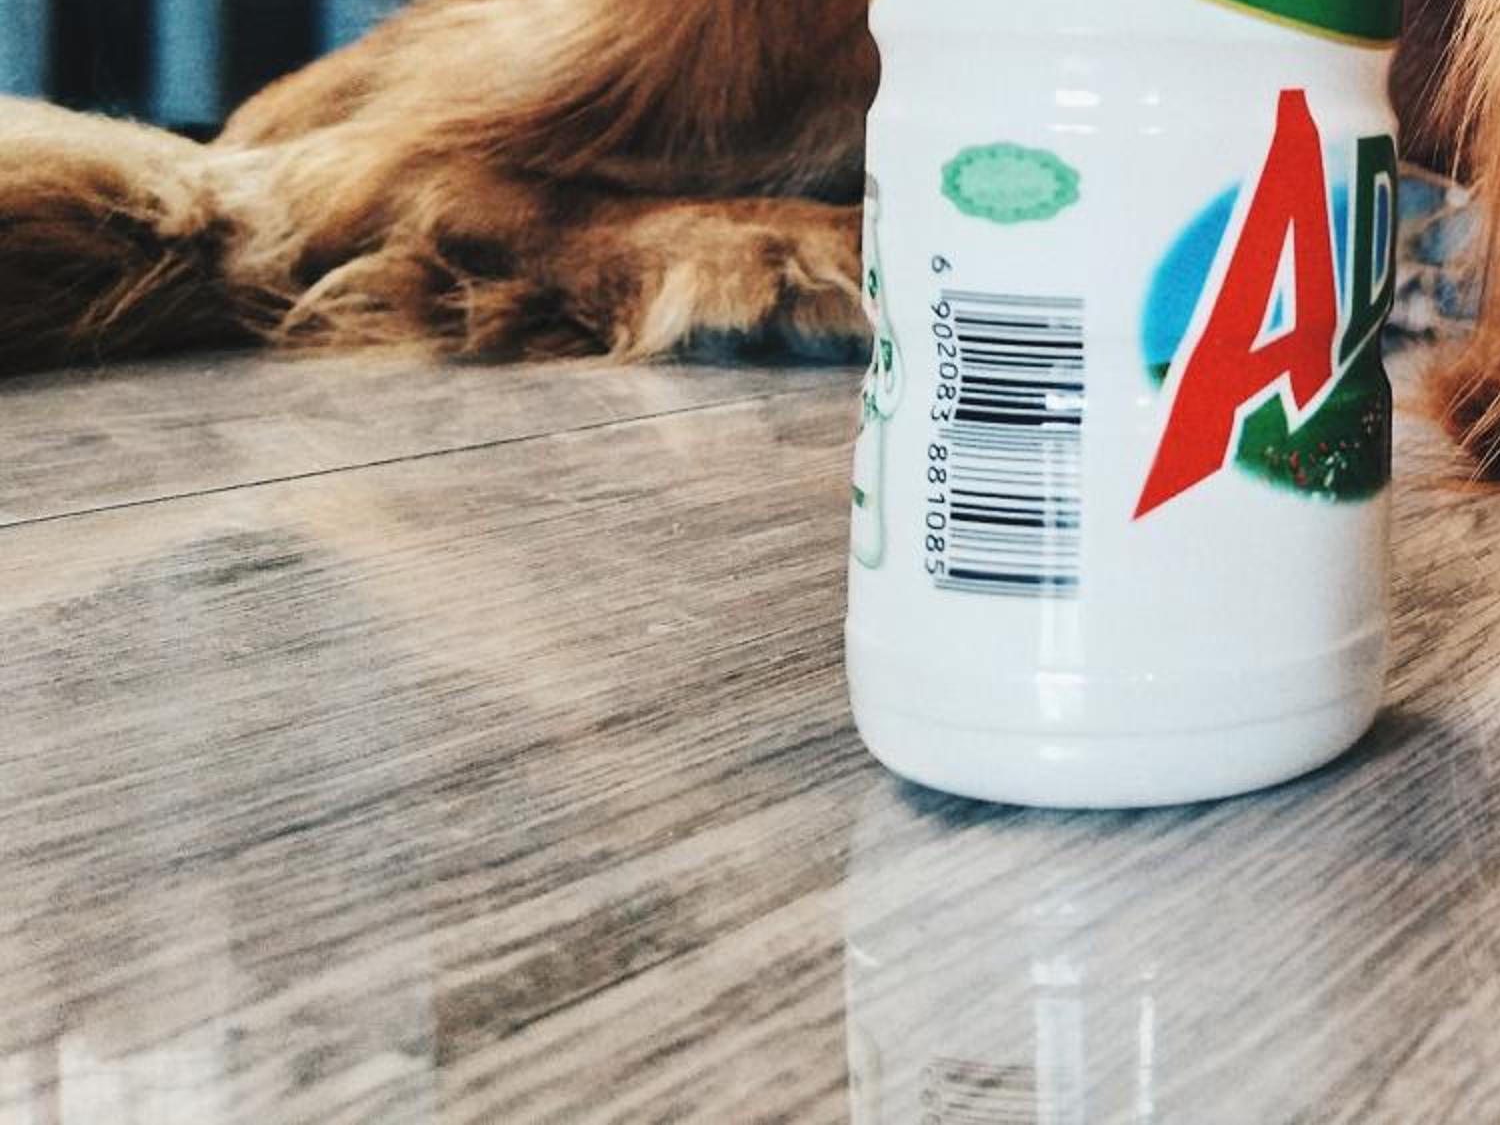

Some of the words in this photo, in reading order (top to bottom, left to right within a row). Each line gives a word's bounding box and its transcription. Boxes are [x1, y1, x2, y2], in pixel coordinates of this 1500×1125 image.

[931, 255, 952, 274] 6
[1132, 88, 1398, 522] AD
[930, 300, 958, 422] 902083
[925, 443, 949, 576] 881085
